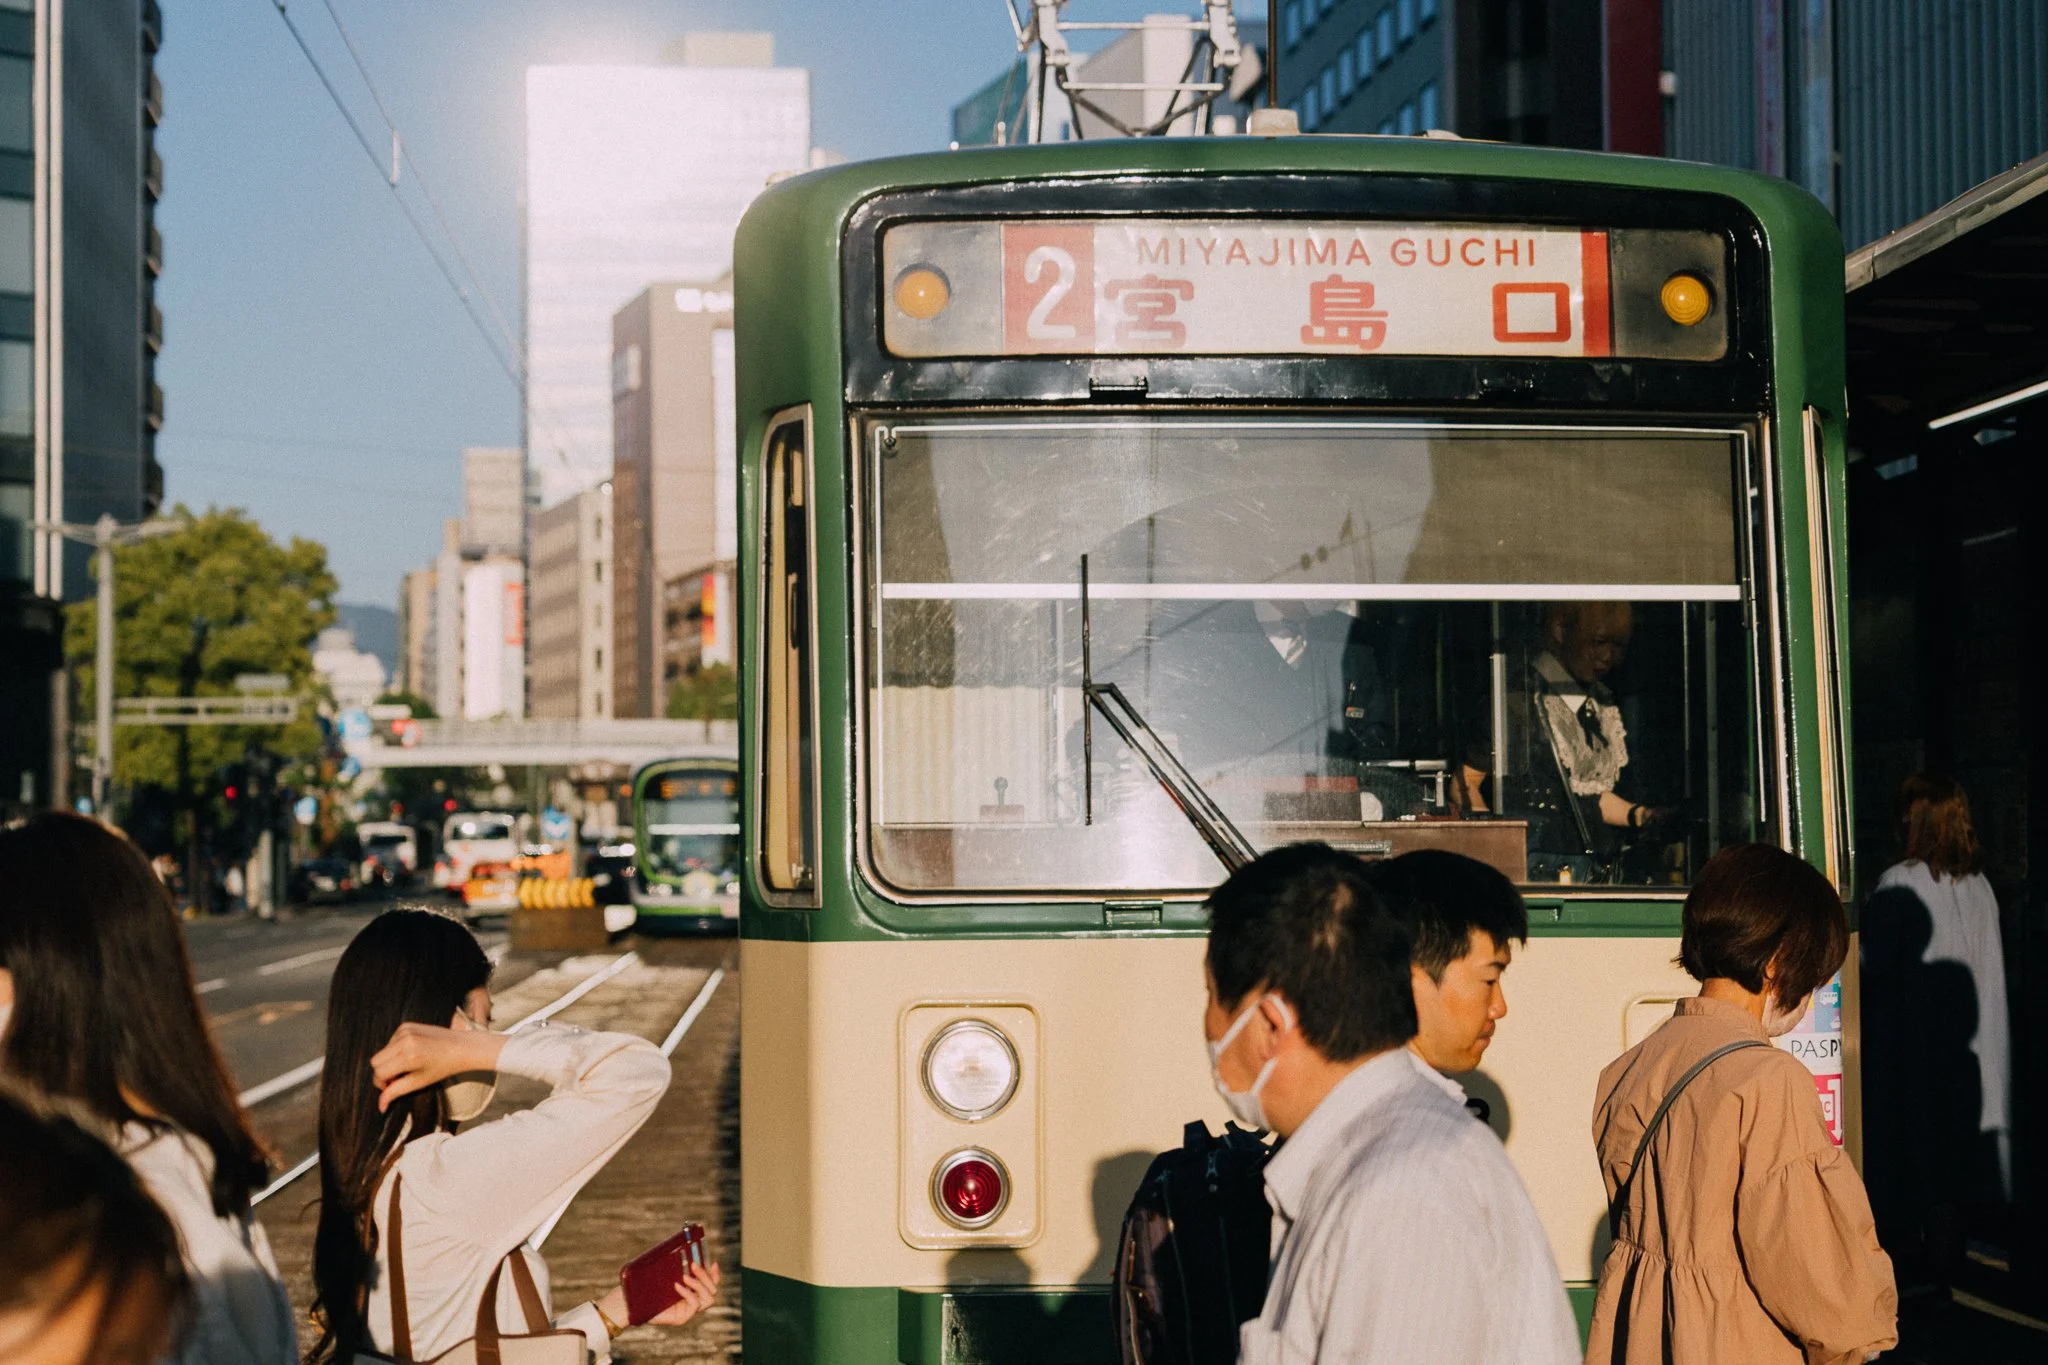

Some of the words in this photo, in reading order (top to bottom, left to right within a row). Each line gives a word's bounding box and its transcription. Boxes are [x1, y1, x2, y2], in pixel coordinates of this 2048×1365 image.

[1136, 237, 1371, 267] MIYAJIMA
[1389, 237, 1536, 268] GUCHI
[1023, 245, 1076, 340] 2
